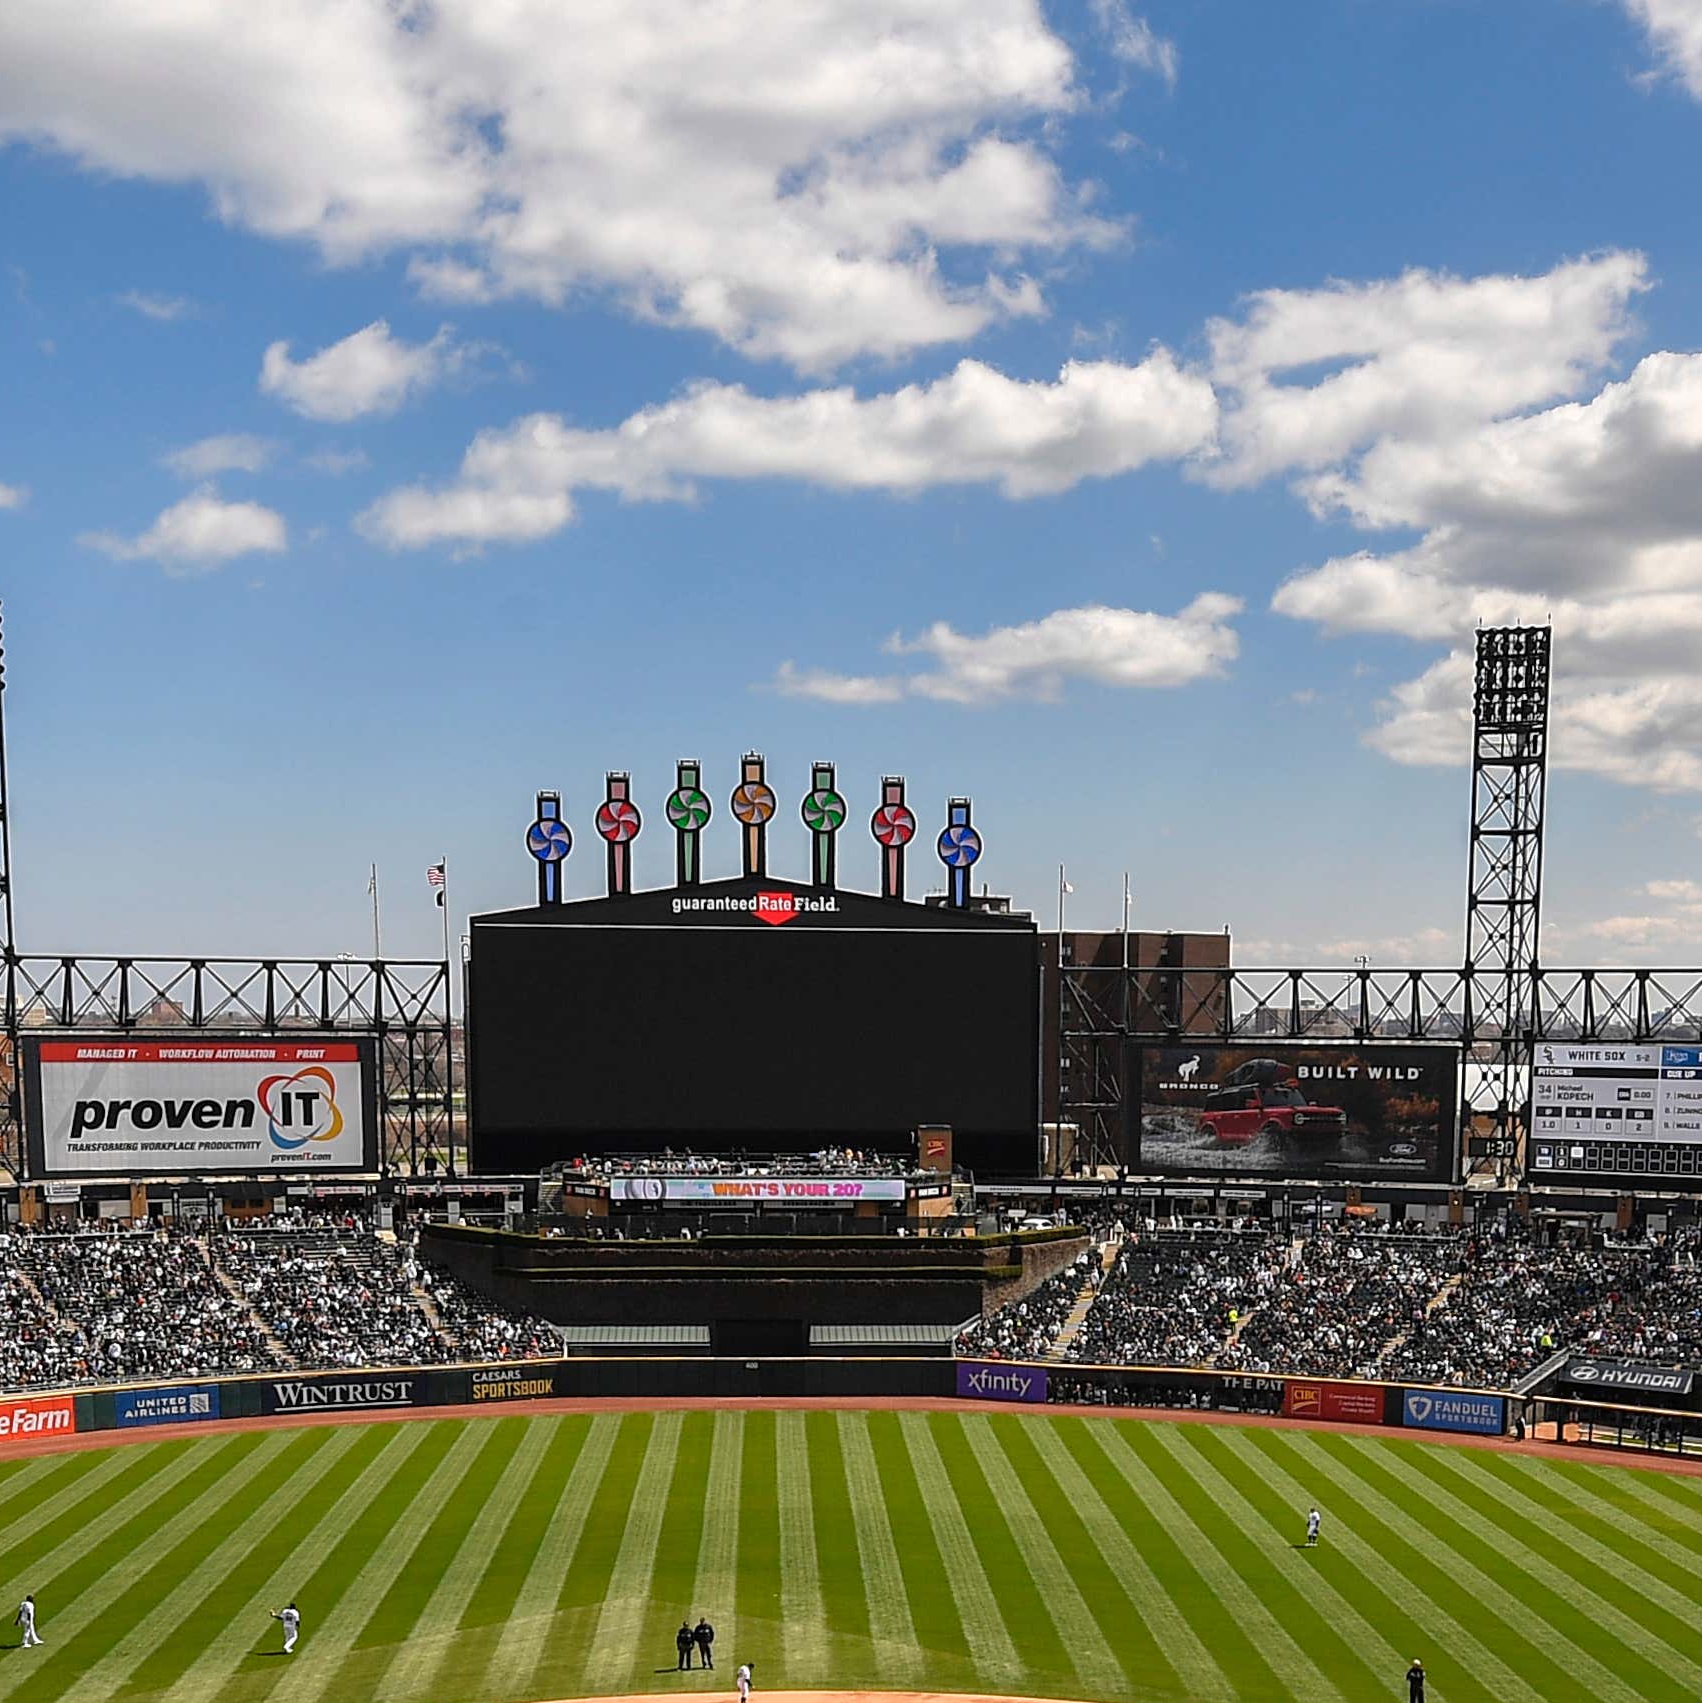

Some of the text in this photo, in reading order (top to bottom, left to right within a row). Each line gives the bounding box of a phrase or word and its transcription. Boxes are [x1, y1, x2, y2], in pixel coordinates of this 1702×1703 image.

[76, 1048, 126, 1059] MANAGED
[159, 1048, 214, 1059] WORKFLOW
[215, 1049, 276, 1059] AUTOMATION
[296, 1049, 325, 1059] PRINT
[1568, 1051, 1626, 1062] WHITE SOX
[1298, 1066, 1358, 1080] BUILT
[1538, 1084, 1583, 1095] 34 Michael
[1557, 1092, 1594, 1101] KOPECH
[70, 1091, 319, 1139] proven IT
[66, 1140, 262, 1153] TRANSFORMING WORKPLACE PRODUCTIVITY
[270, 1152, 332, 1163] provenIT.com
[712, 1182, 863, 1198] WHAT'S YOUR 20?
[473, 1369, 521, 1387] CAESARS
[968, 1371, 1032, 1397] xfinity
[1601, 1370, 1683, 1390] HYUNDAI
[274, 1380, 413, 1406] WINTRUST
[473, 1379, 554, 1400] SPORTSBOOK
[1293, 1386, 1319, 1400] CIBC
[137, 1395, 187, 1411] UNITED
[1434, 1400, 1499, 1418] FANDUEL
[124, 1404, 188, 1418] AIRLINES
[1434, 1413, 1499, 1426] SPORTSBOOK
